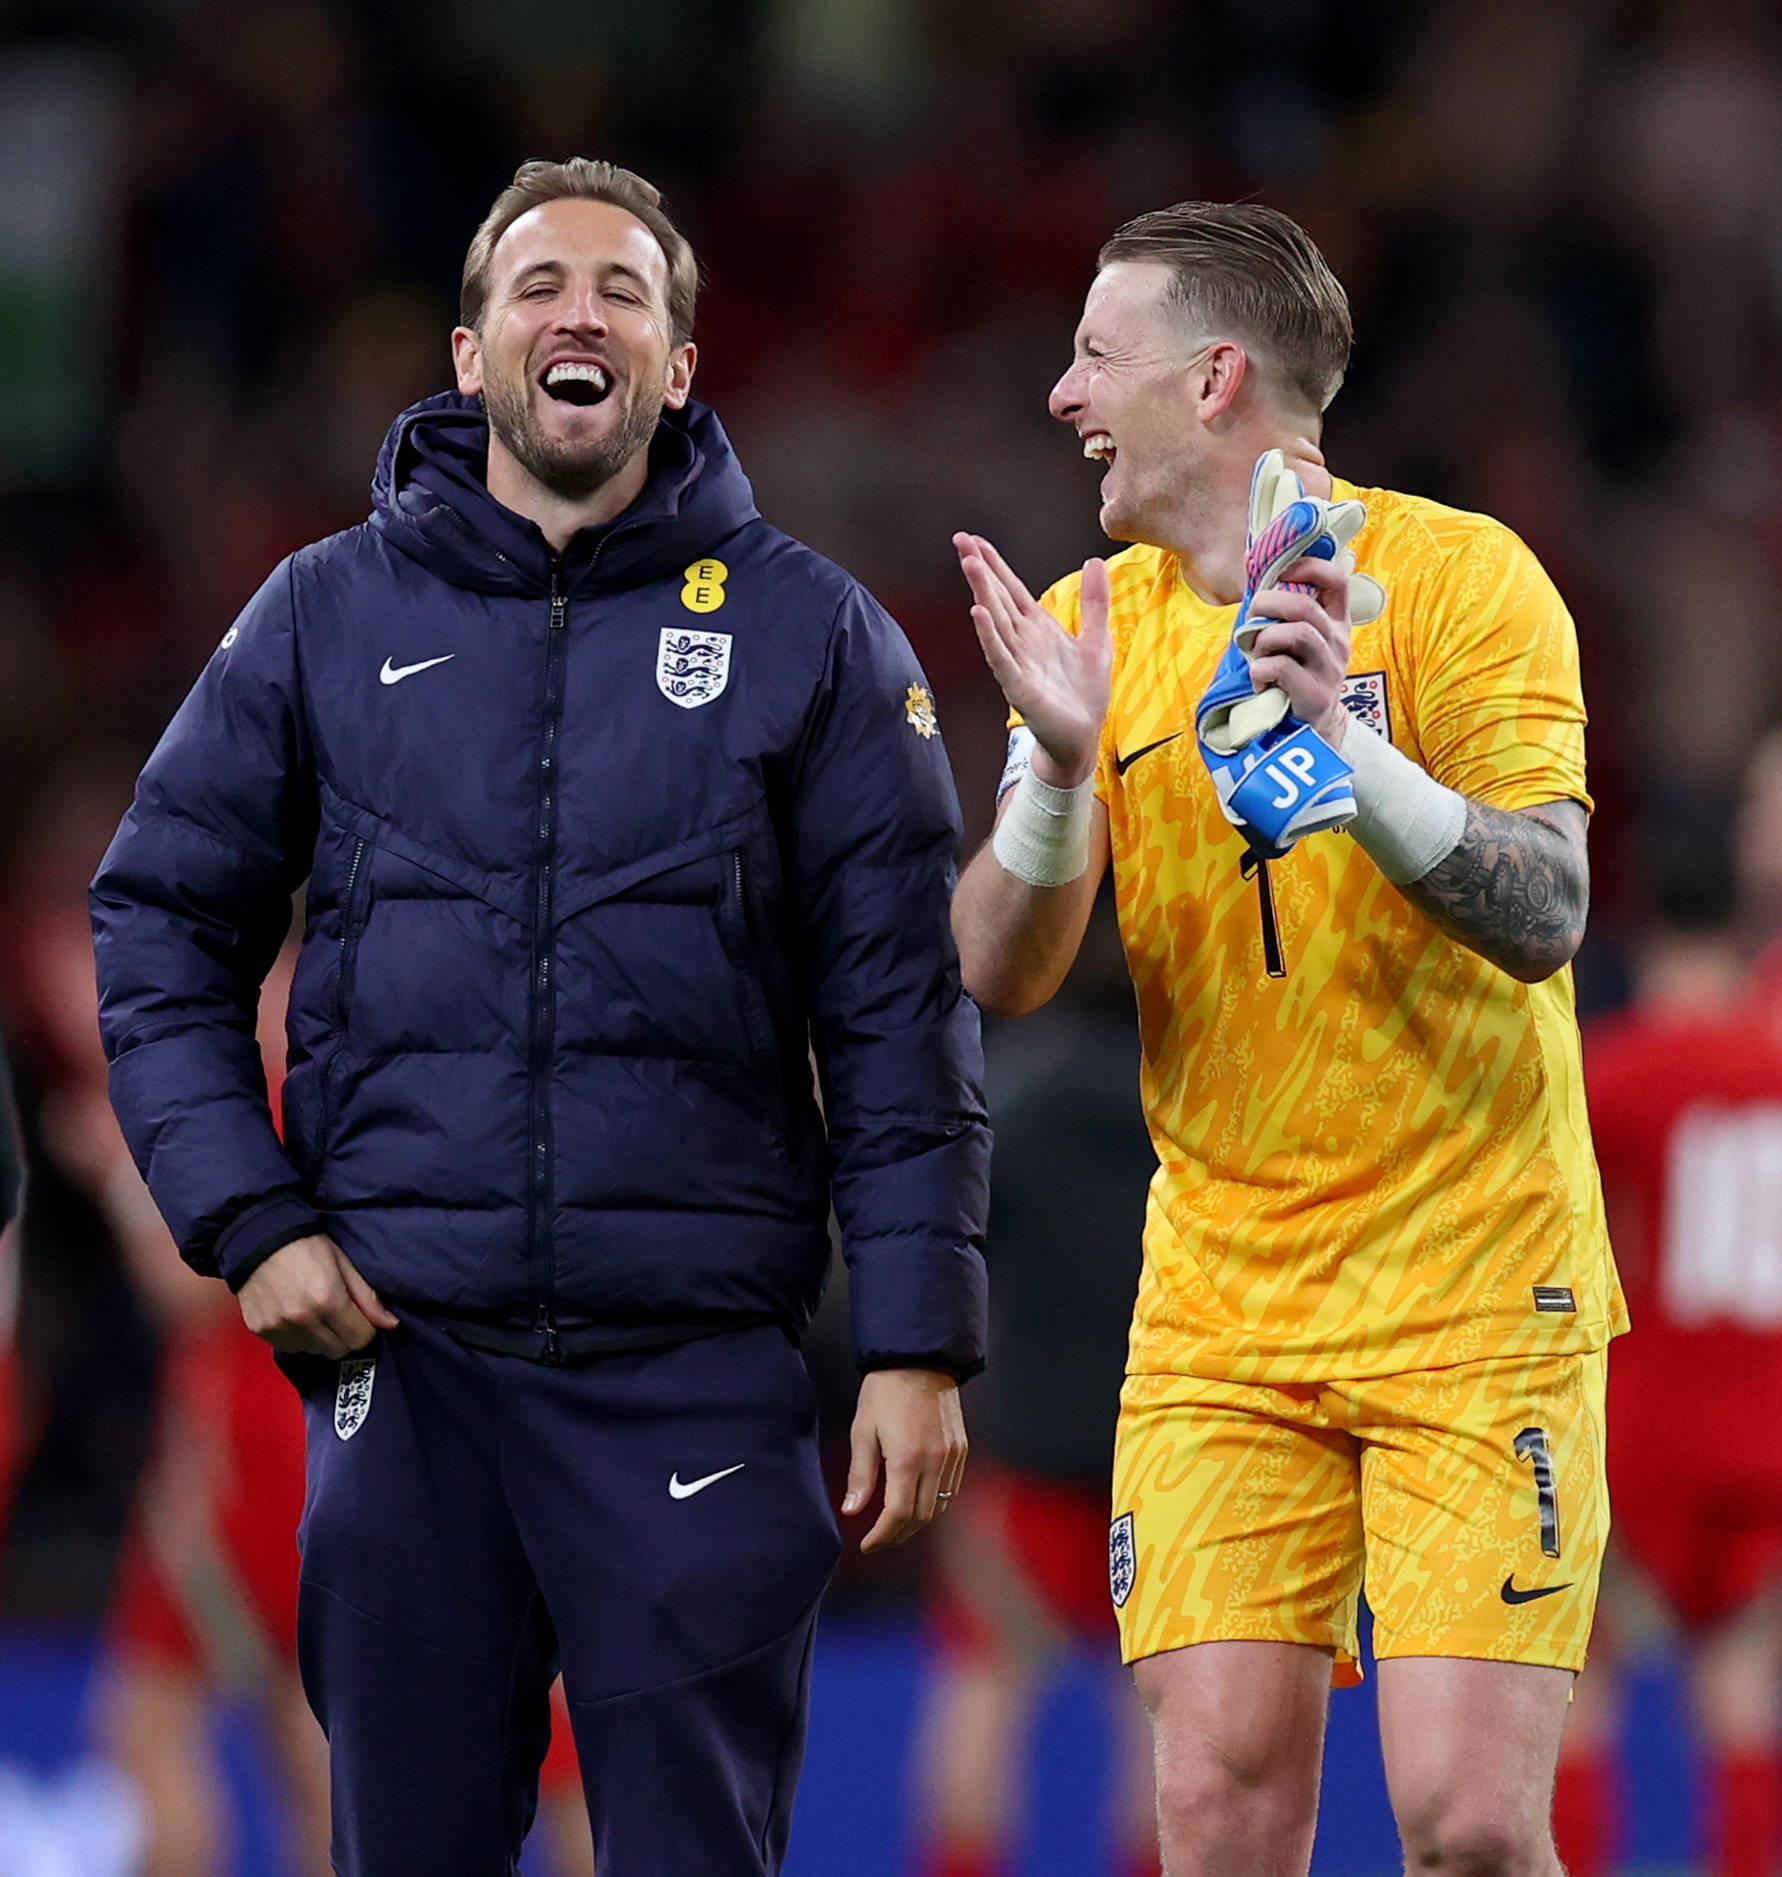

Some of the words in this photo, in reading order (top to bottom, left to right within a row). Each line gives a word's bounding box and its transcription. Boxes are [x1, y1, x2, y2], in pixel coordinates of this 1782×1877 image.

[1263, 746, 1317, 810] JP
[1239, 846, 1287, 978] 1
[1512, 1426, 1561, 1559] 1
